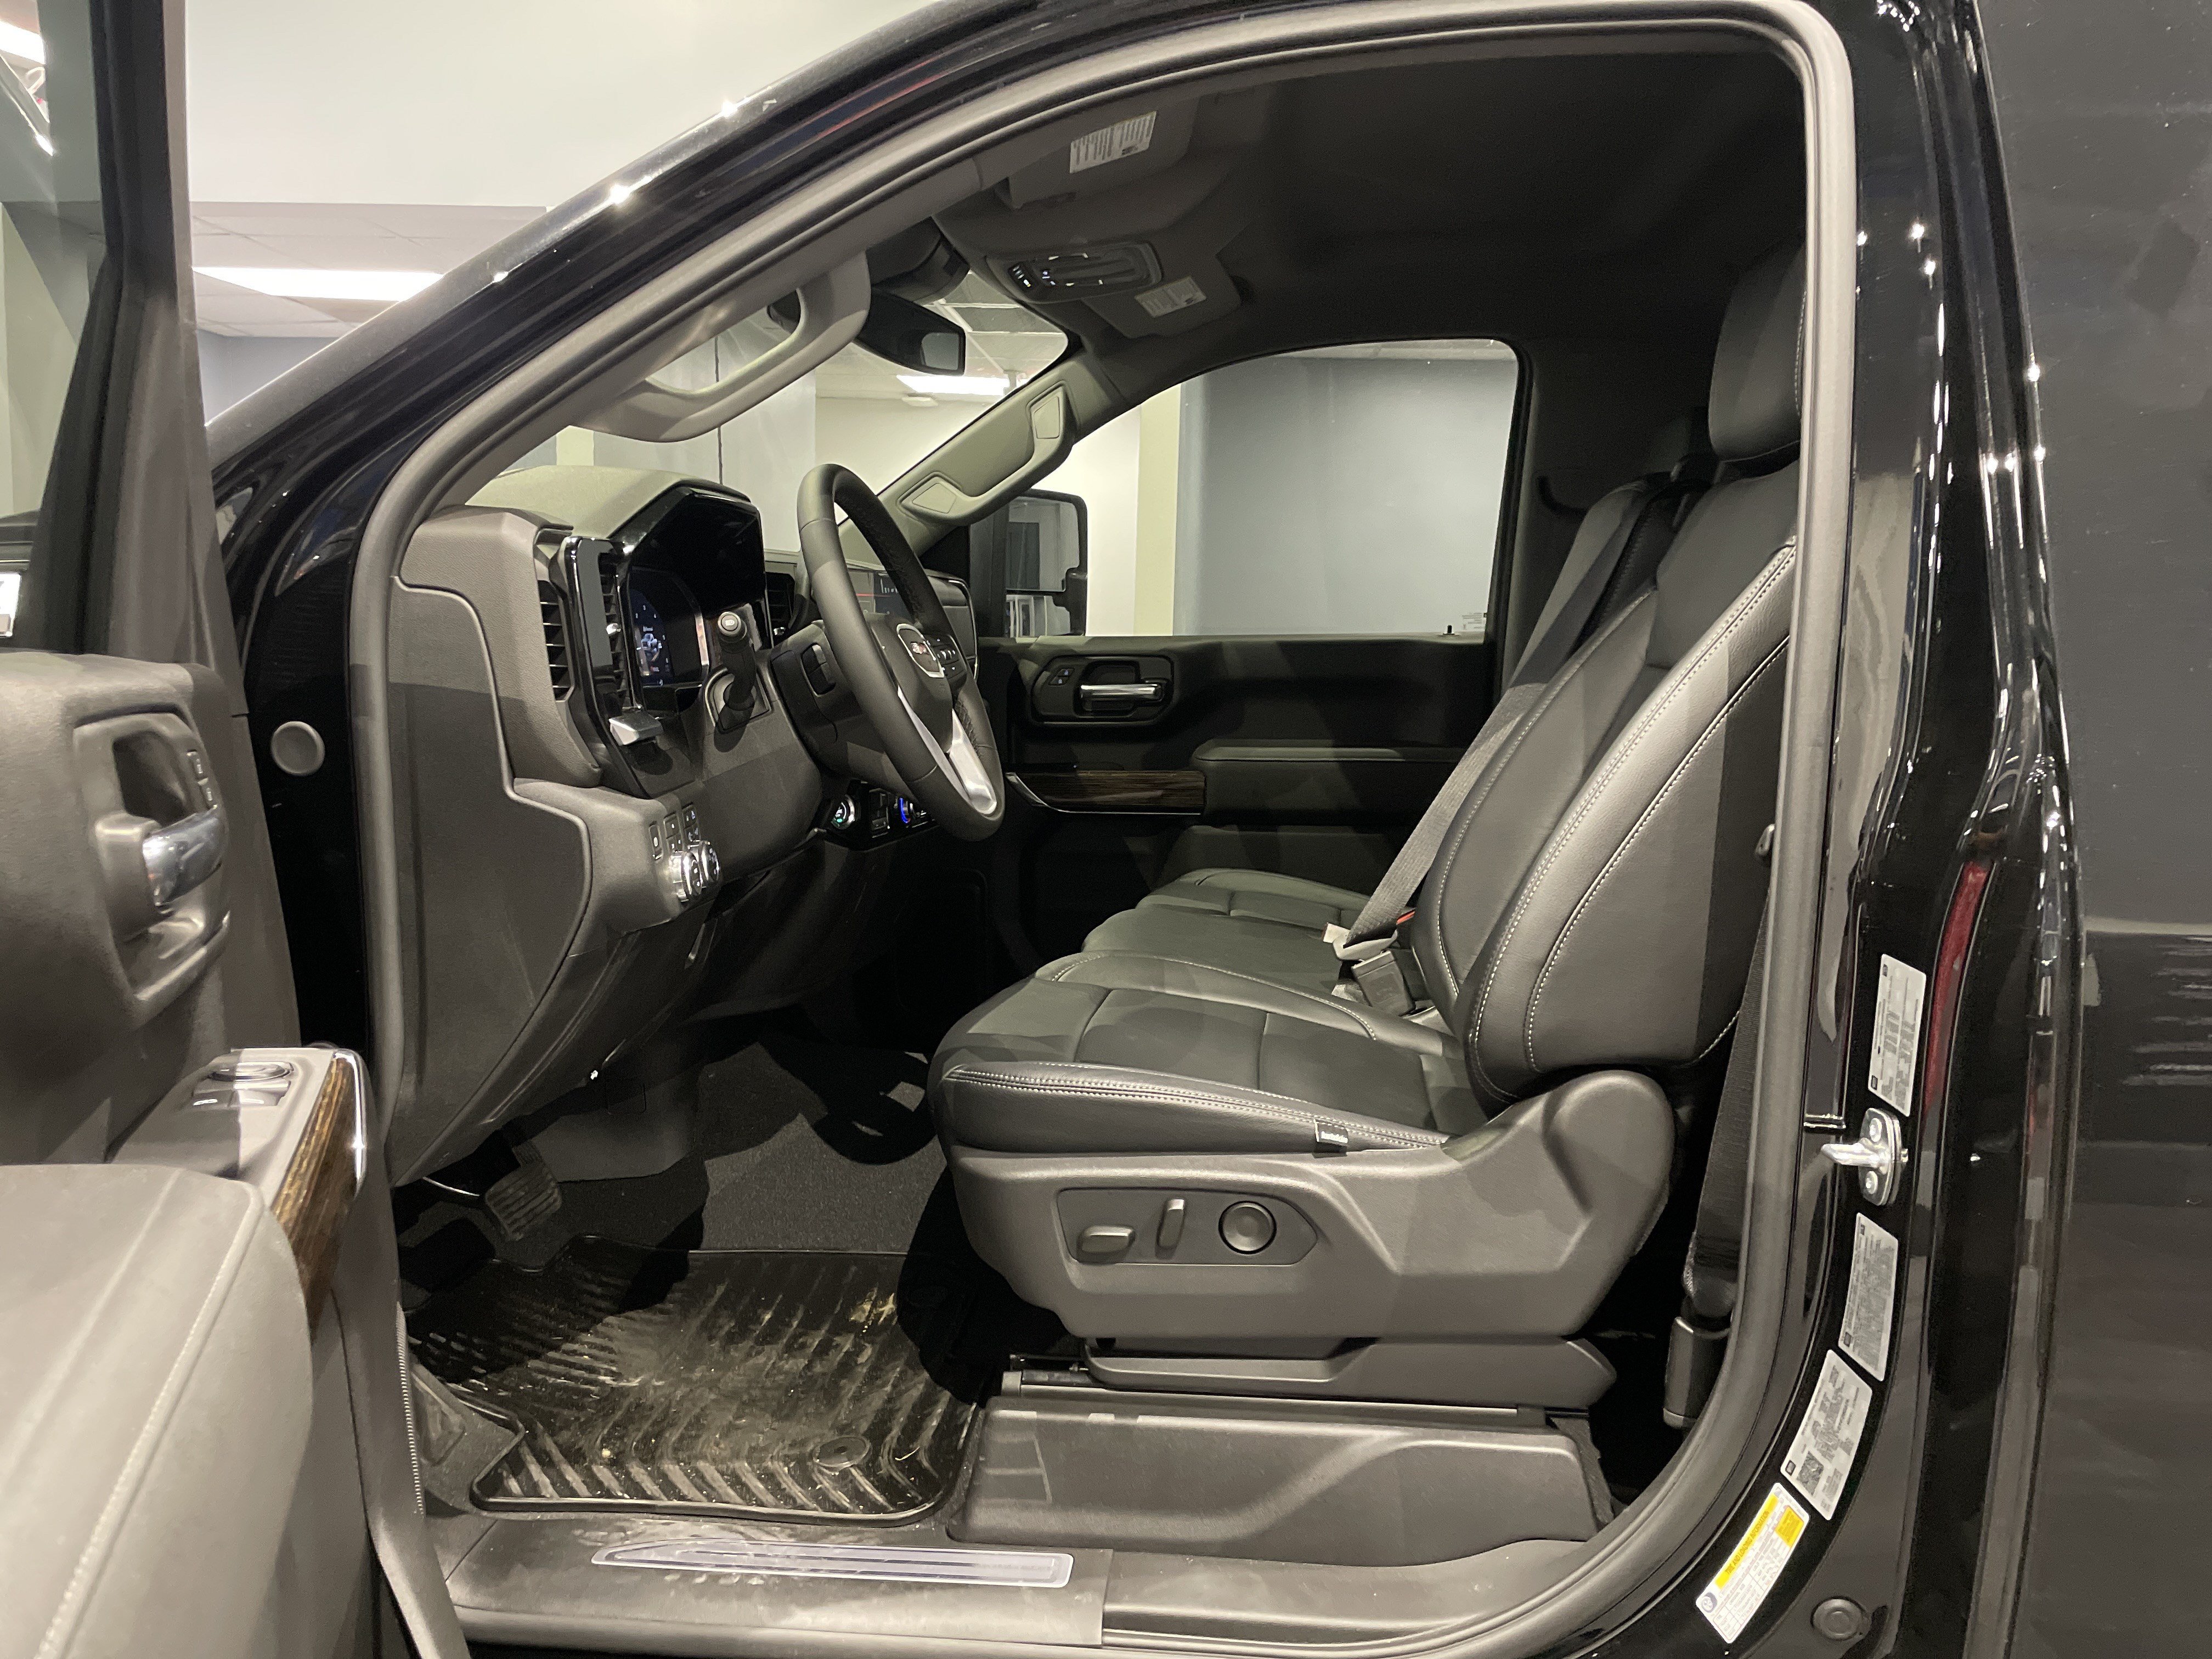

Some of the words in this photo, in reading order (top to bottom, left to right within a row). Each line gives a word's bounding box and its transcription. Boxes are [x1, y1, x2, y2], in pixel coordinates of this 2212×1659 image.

[1725, 1563, 1735, 1575] TIRE
[1733, 1555, 1741, 1566] AND
[1739, 1537, 1753, 1557] LOADING
